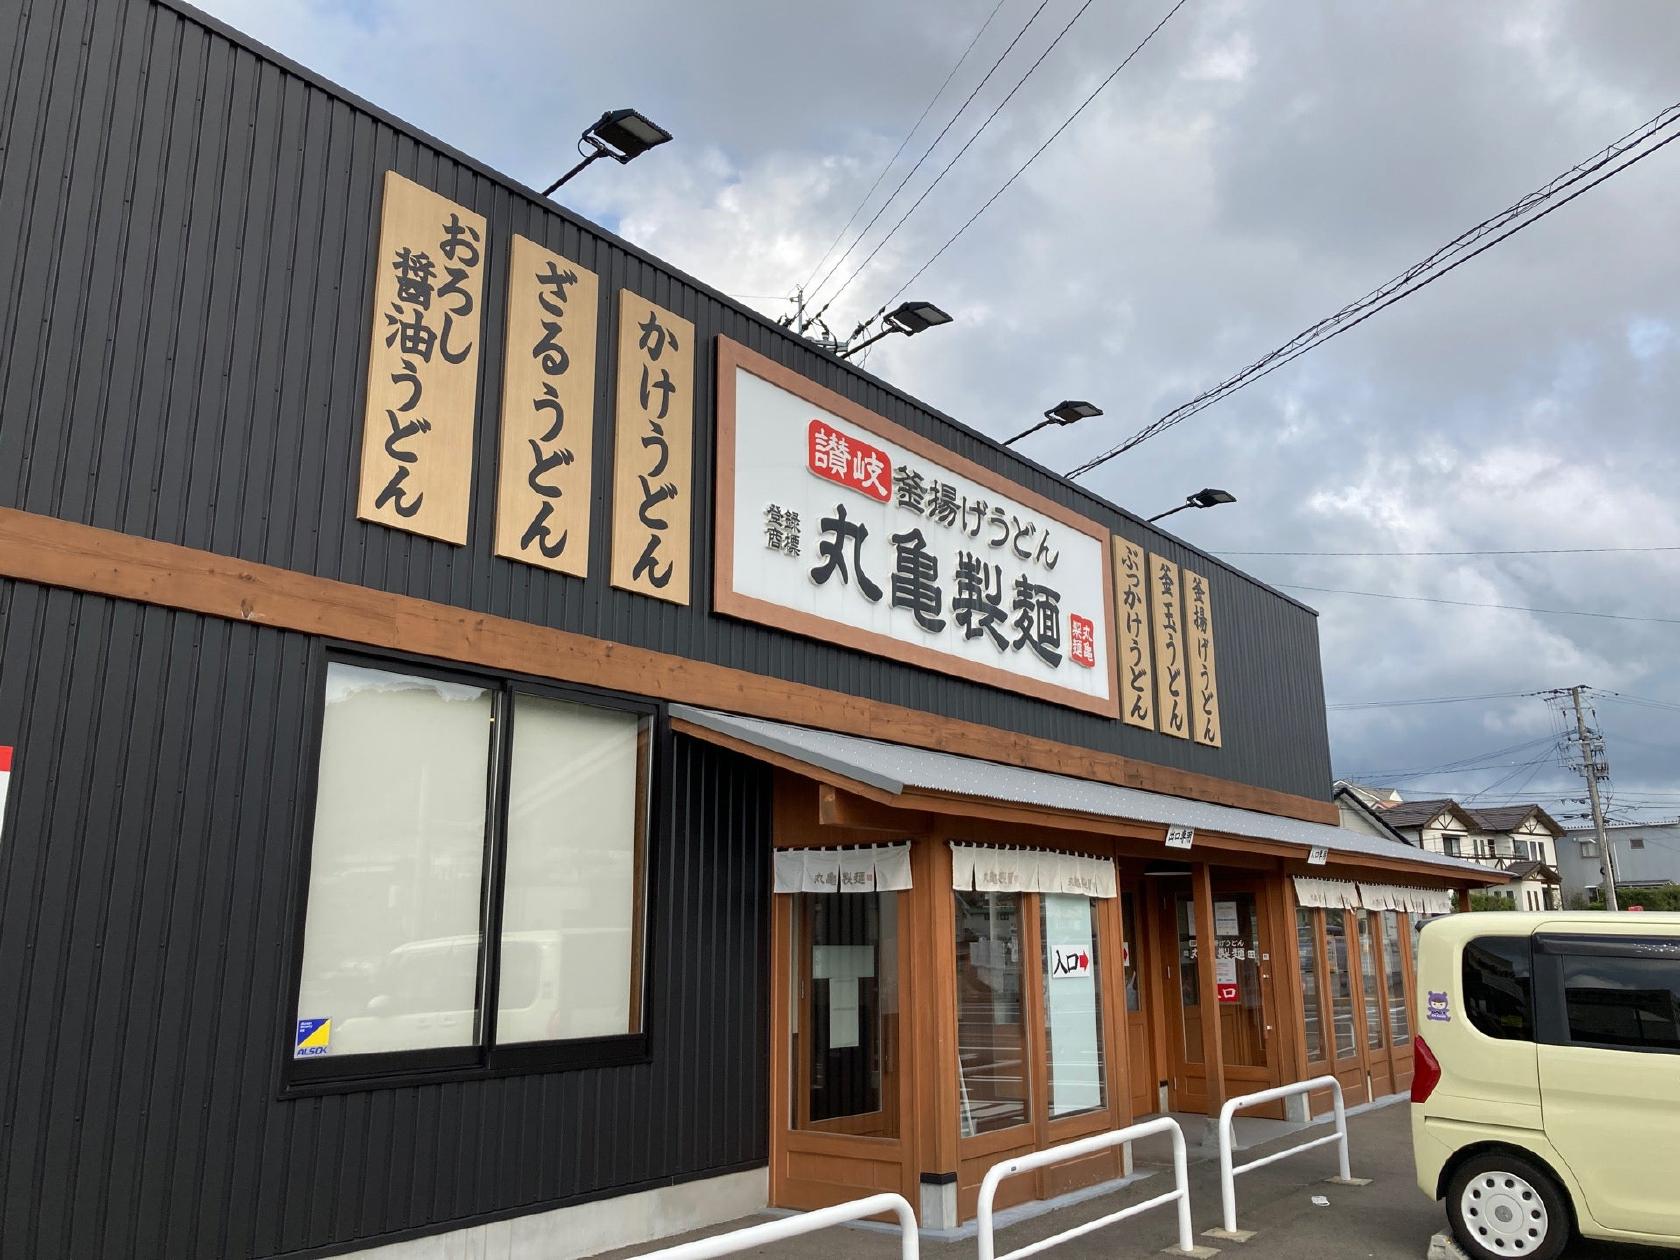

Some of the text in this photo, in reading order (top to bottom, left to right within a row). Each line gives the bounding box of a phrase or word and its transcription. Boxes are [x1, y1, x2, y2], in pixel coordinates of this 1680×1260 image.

[437, 213, 480, 364] おろし
[375, 247, 438, 518] 醤油うどん
[520, 261, 578, 558] ざるうどん
[632, 311, 679, 588] かけうどん
[814, 427, 1060, 570] 讃岐 釜揚げうどん
[810, 503, 1063, 669] 丸亀製麺
[1121, 546, 1148, 721] ぶっかけうどん
[1158, 563, 1184, 732] 釜玉うどん
[1191, 577, 1216, 743] 釜揚げうどん
[1053, 948, 1079, 975] 入口
[296, 1046, 328, 1057] ALSOK
